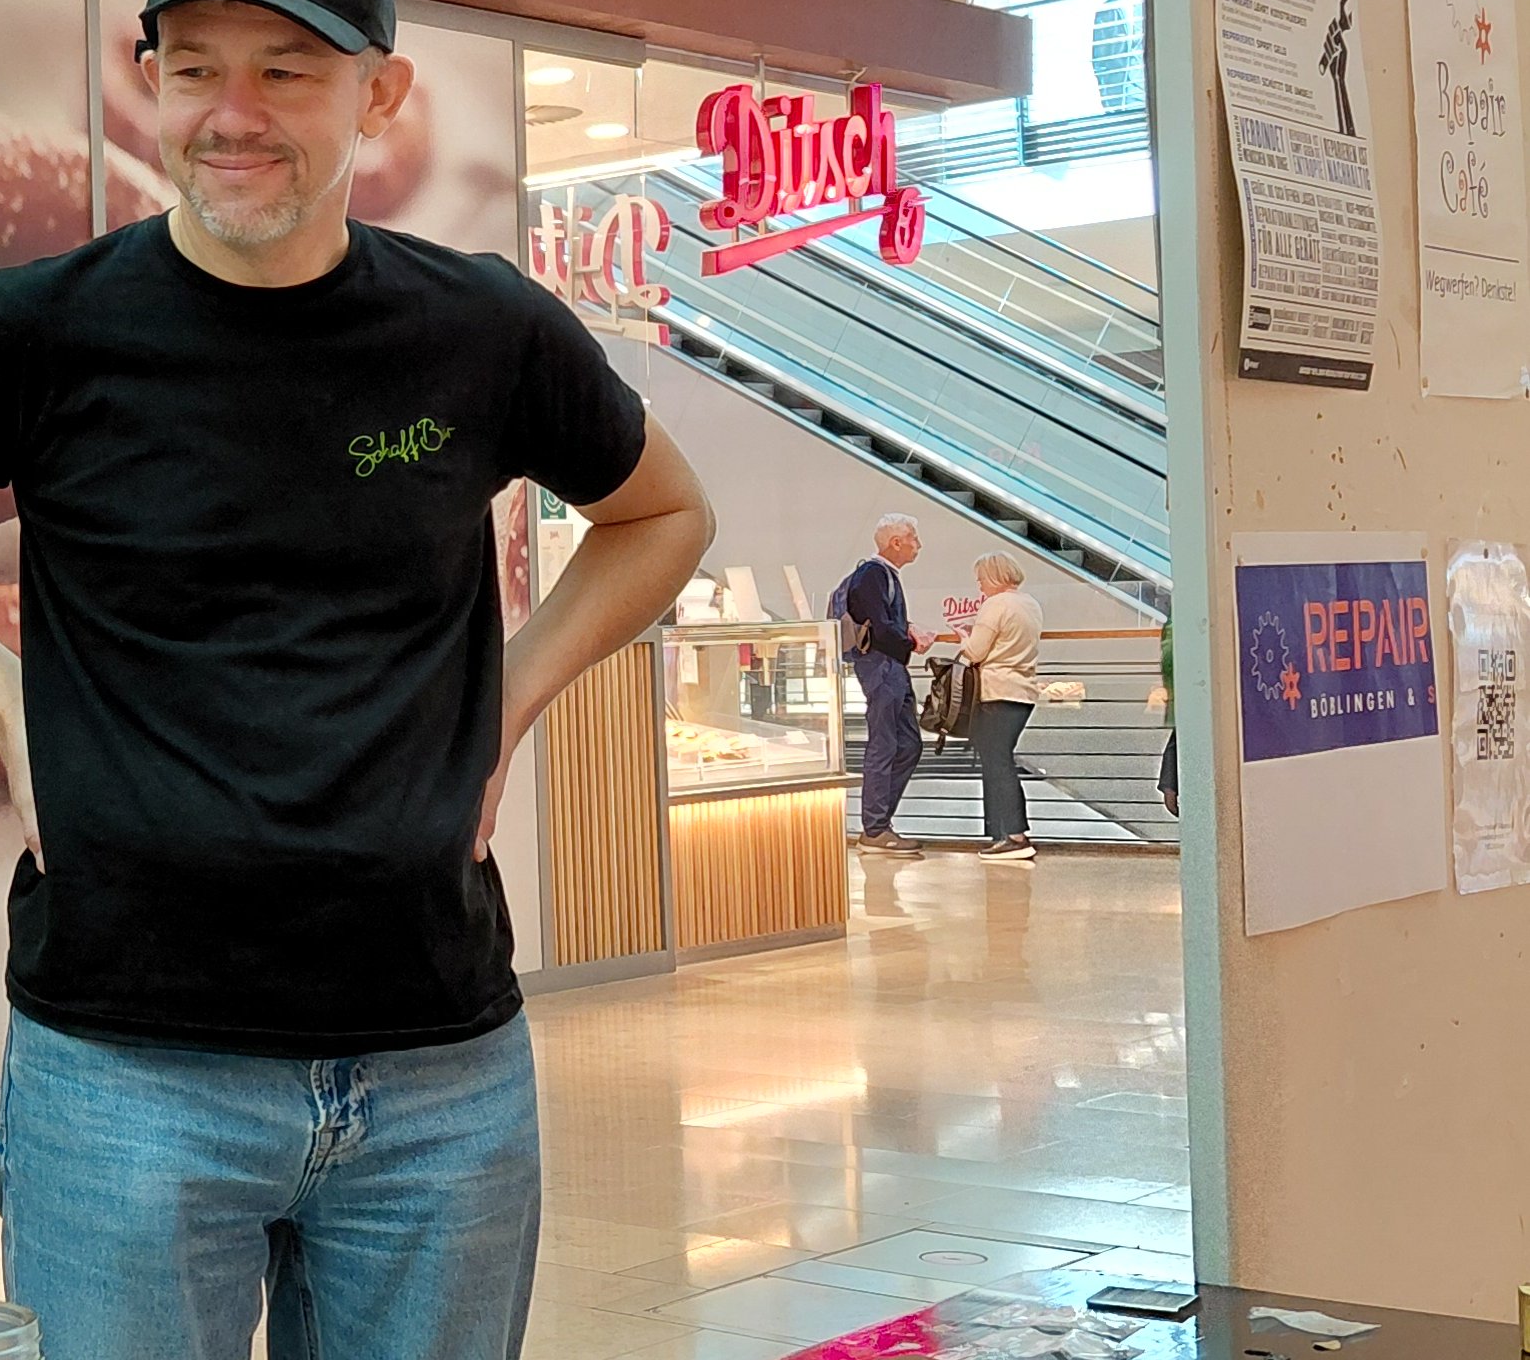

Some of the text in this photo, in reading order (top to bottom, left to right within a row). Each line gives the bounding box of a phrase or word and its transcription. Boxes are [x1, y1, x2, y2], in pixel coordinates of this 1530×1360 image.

[1436, 61, 1507, 145] Repair
[696, 83, 899, 230] Ditsch
[1240, 116, 1285, 154] VERBINDET
[1440, 150, 1489, 219] Café
[1258, 225, 1321, 263] FÜR ALLE GERÄTE
[1425, 269, 1516, 302] Wegwerfen? Denkste!
[1303, 597, 1429, 673] REPAIR
[1310, 690, 1395, 719] BÖBLINGEN
[1407, 688, 1416, 706] &
